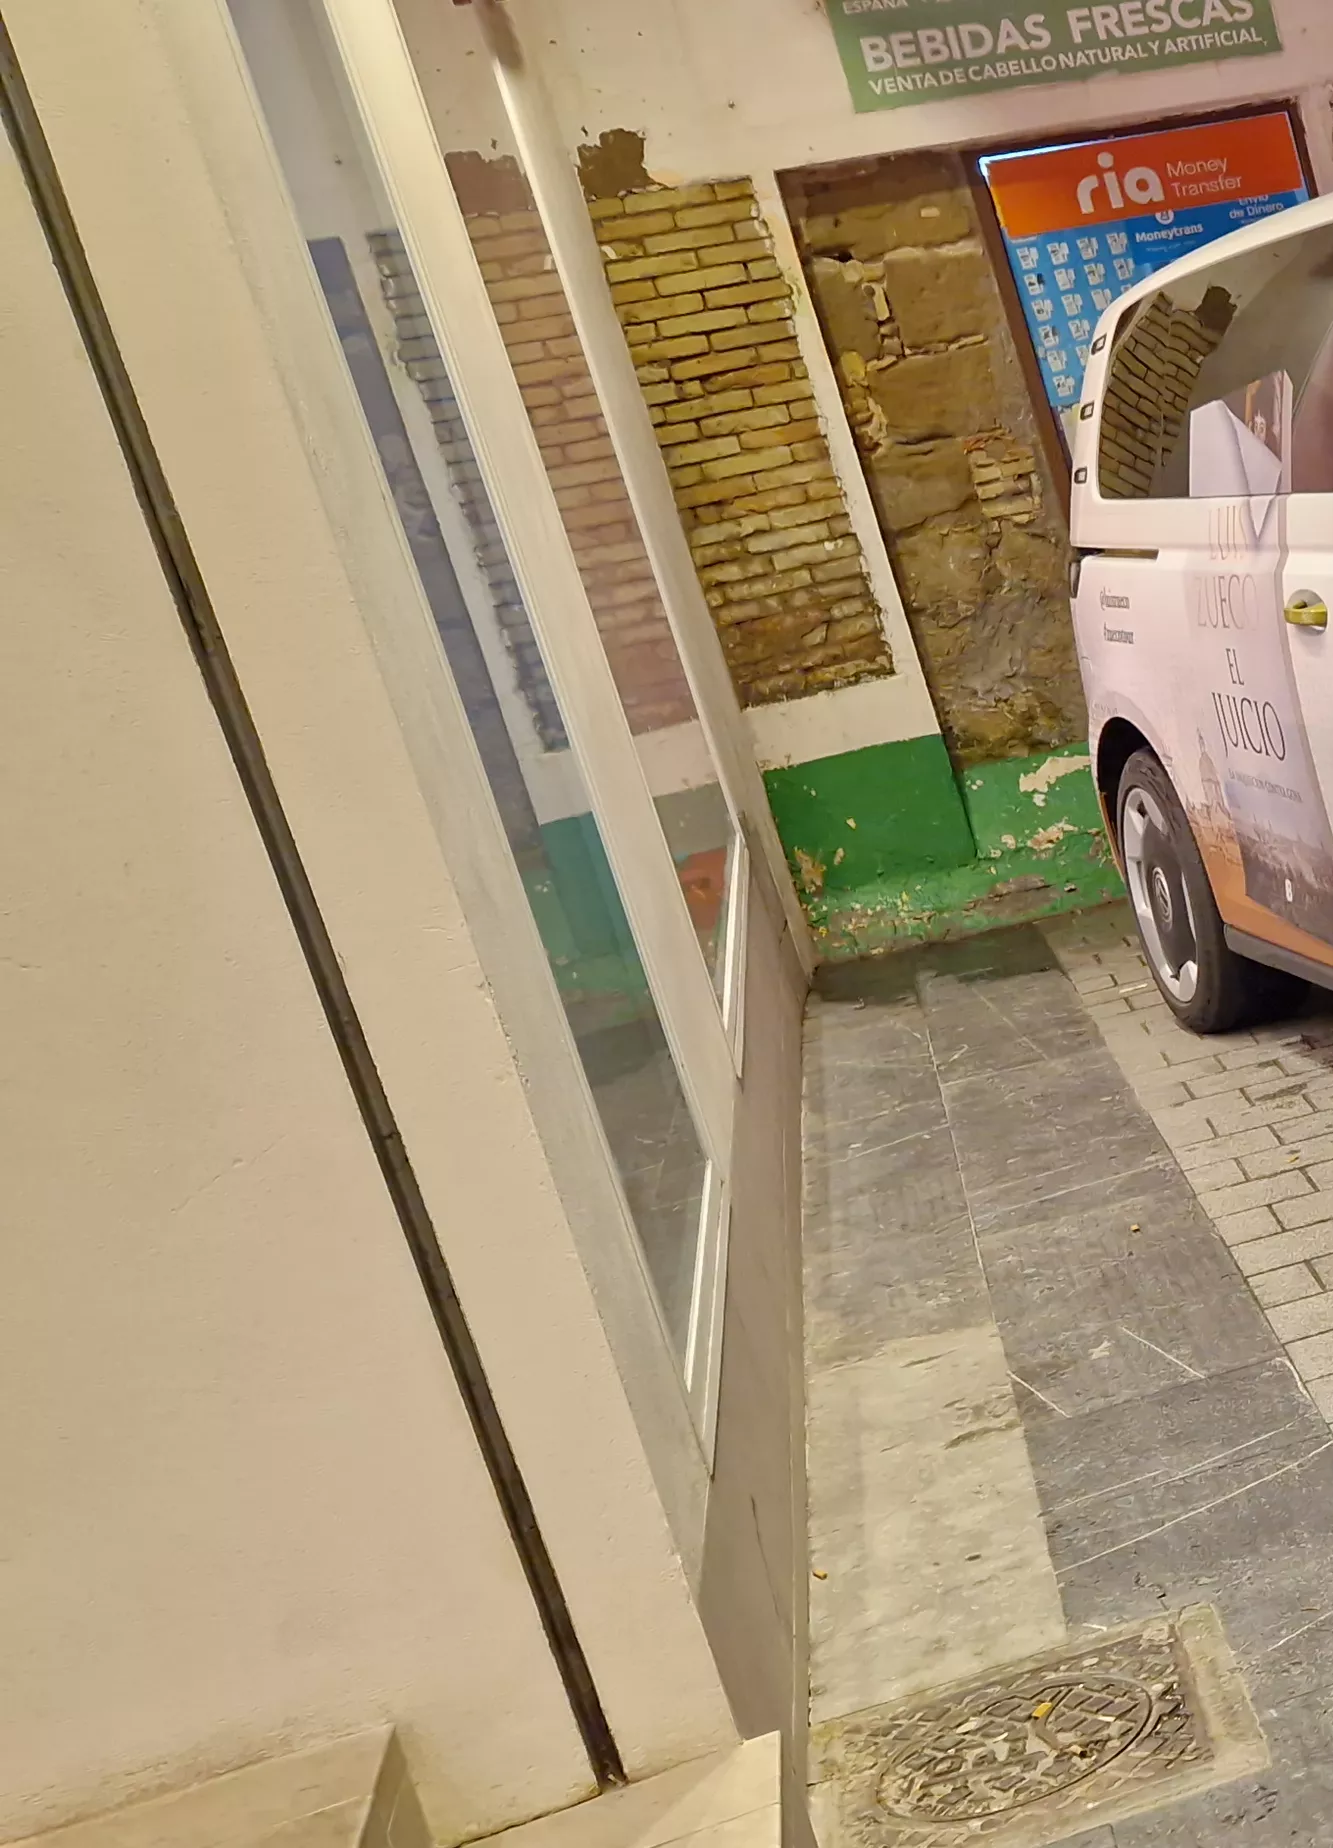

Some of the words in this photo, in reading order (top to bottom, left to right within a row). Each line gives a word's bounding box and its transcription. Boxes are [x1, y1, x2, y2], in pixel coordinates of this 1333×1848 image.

[859, 13, 1052, 73] BEBIDAS
[1066, 0, 1254, 44] FRESCAS
[868, 72, 938, 96] VENTA
[940, 68, 967, 85] DE
[968, 56, 1057, 82] CABELLO
[1058, 43, 1149, 70] NATURAL
[1148, 41, 1161, 56] Y
[1076, 152, 1166, 215] ria
[1166, 156, 1230, 179] Money
[1171, 174, 1243, 198] Transfer
[1135, 223, 1204, 243] Moneytrans
[1195, 573, 1260, 631] ZUECO
[1226, 648, 1245, 686] EL
[1211, 692, 1286, 761] JUICIO
